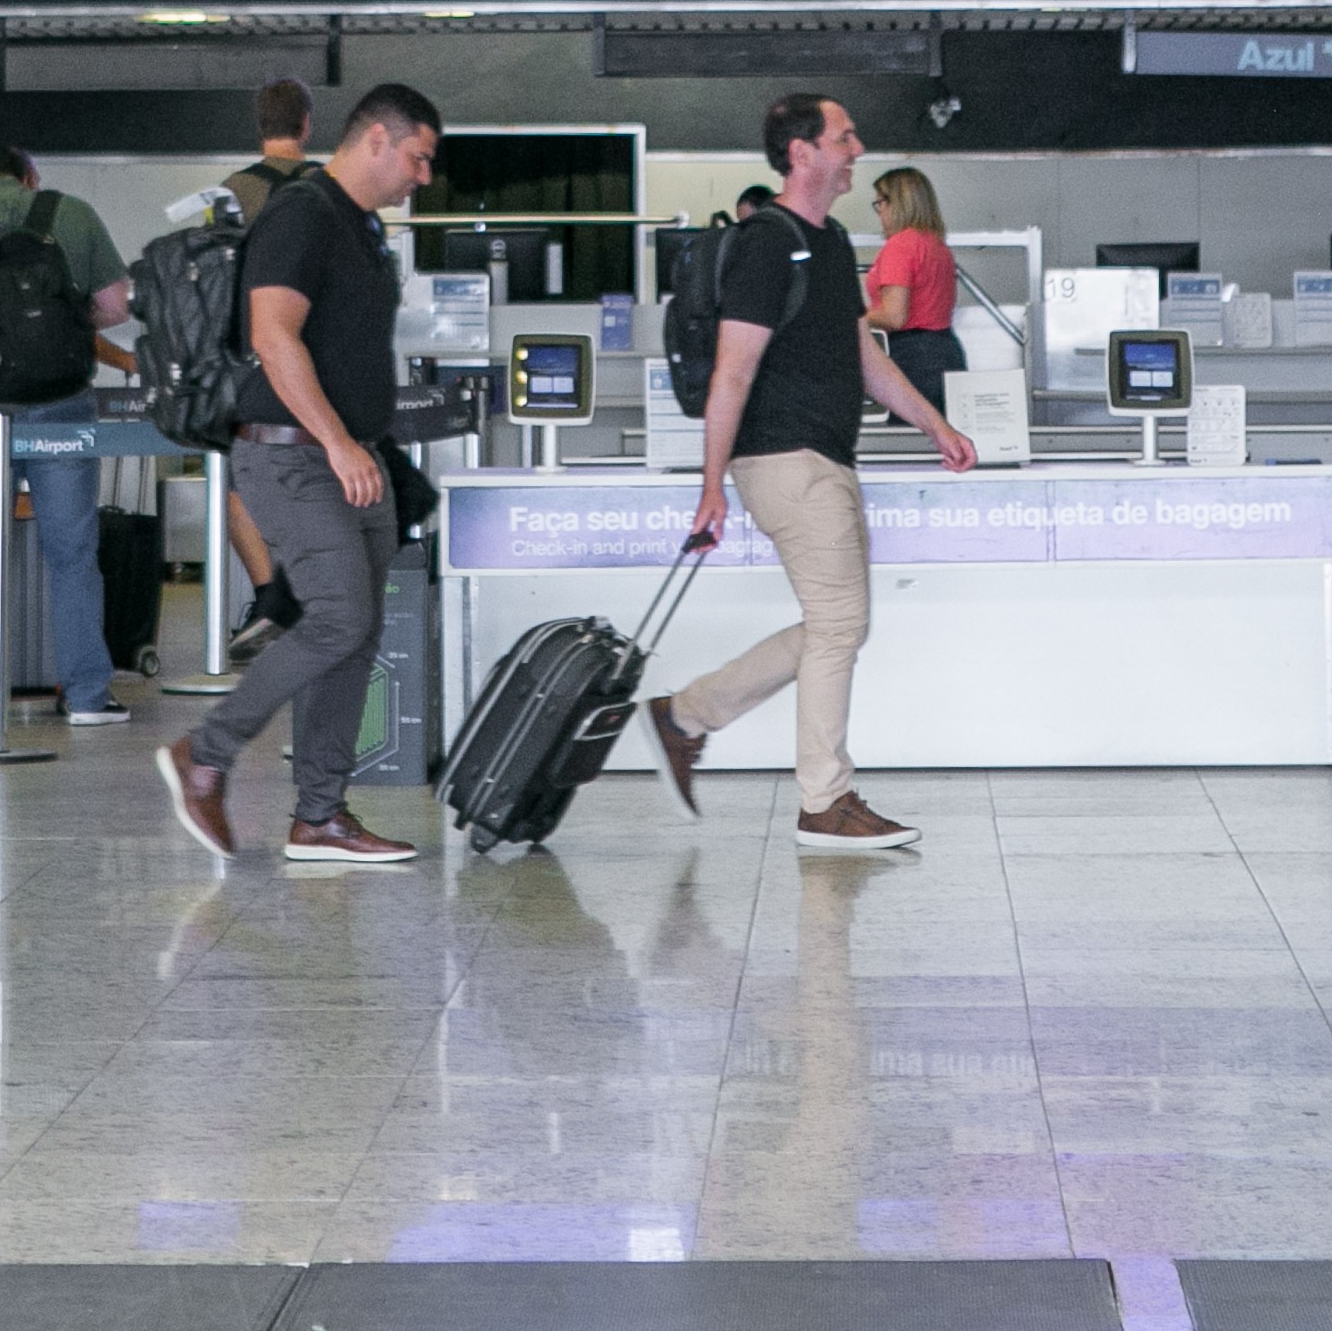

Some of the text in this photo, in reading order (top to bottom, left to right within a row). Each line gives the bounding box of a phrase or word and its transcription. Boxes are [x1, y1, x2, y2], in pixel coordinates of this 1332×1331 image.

[1237, 40, 1314, 71] Azul
[1047, 277, 1075, 298] 19
[109, 400, 146, 413] BHAir
[14, 438, 84, 455] BHAirport
[509, 506, 579, 537] Faça
[587, 510, 638, 531] seu
[928, 507, 979, 528] sua
[986, 501, 1105, 532] etiqueta
[1111, 499, 1148, 524] de
[1155, 498, 1292, 530] bagagem
[511, 540, 587, 556] Check-in
[591, 540, 625, 555] and
[629, 539, 666, 558] print
